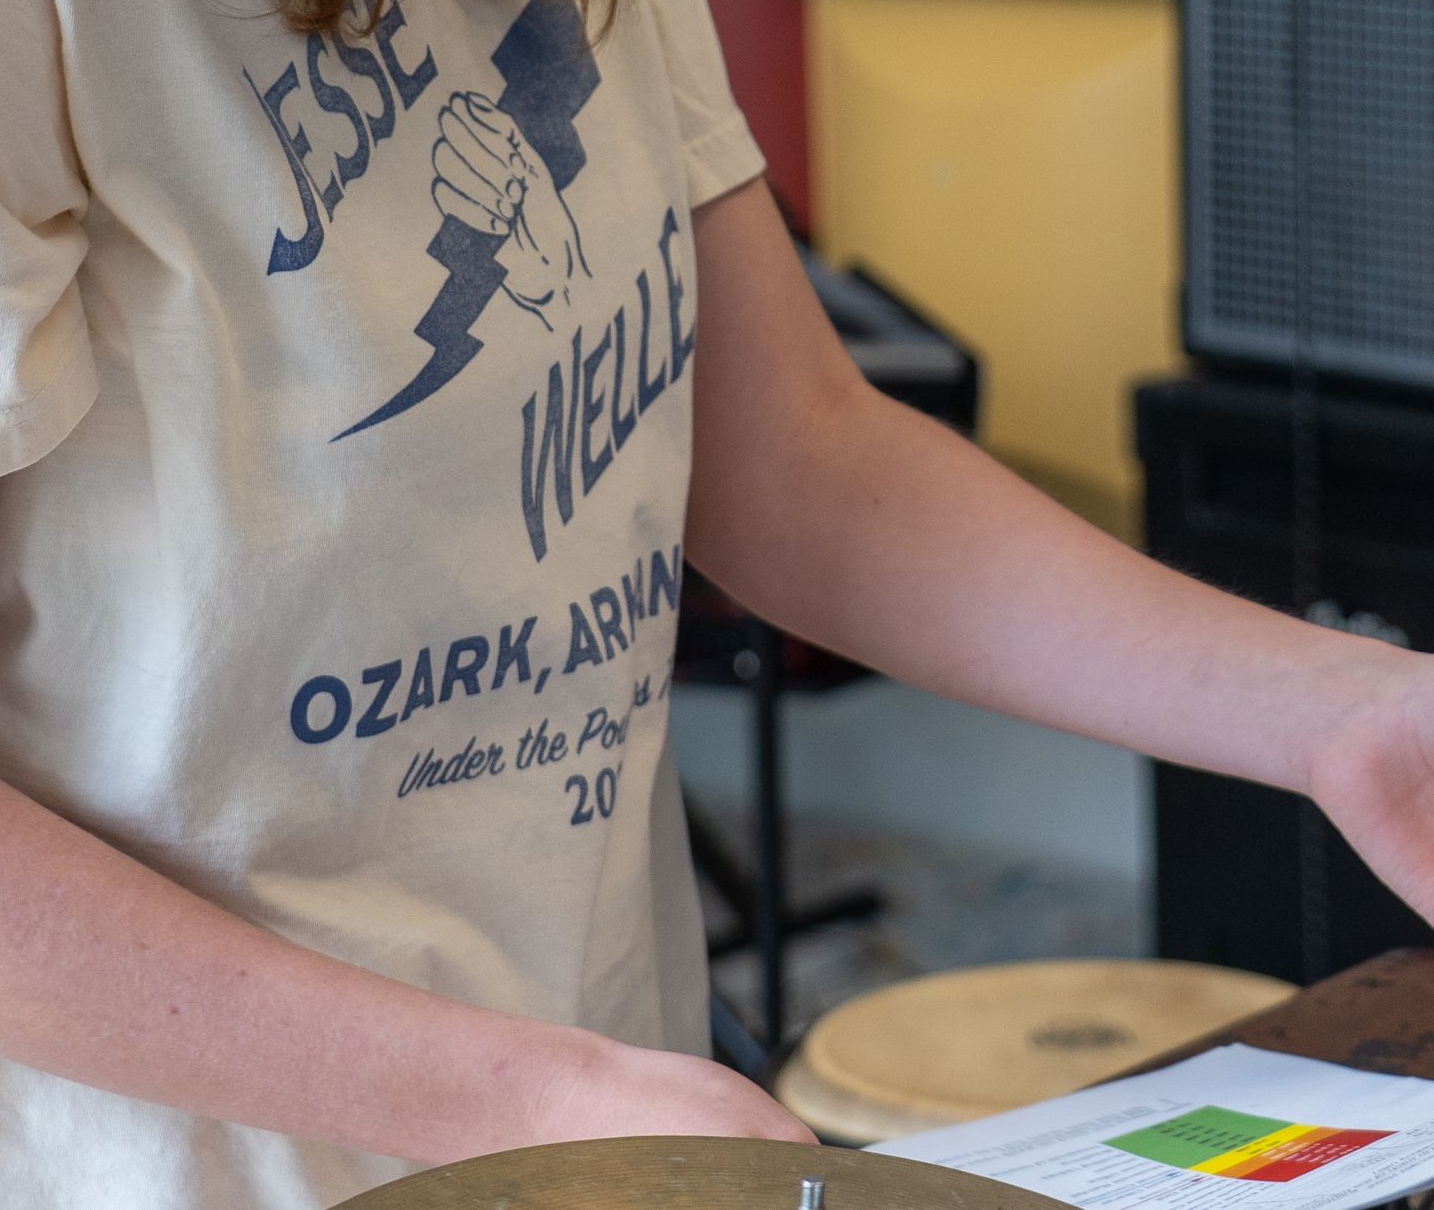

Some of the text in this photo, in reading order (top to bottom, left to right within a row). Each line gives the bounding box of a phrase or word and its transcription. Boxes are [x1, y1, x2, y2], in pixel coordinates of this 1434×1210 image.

[290, 616, 552, 745] OZARK,
[398, 735, 506, 799] Under
[516, 718, 569, 771] the
